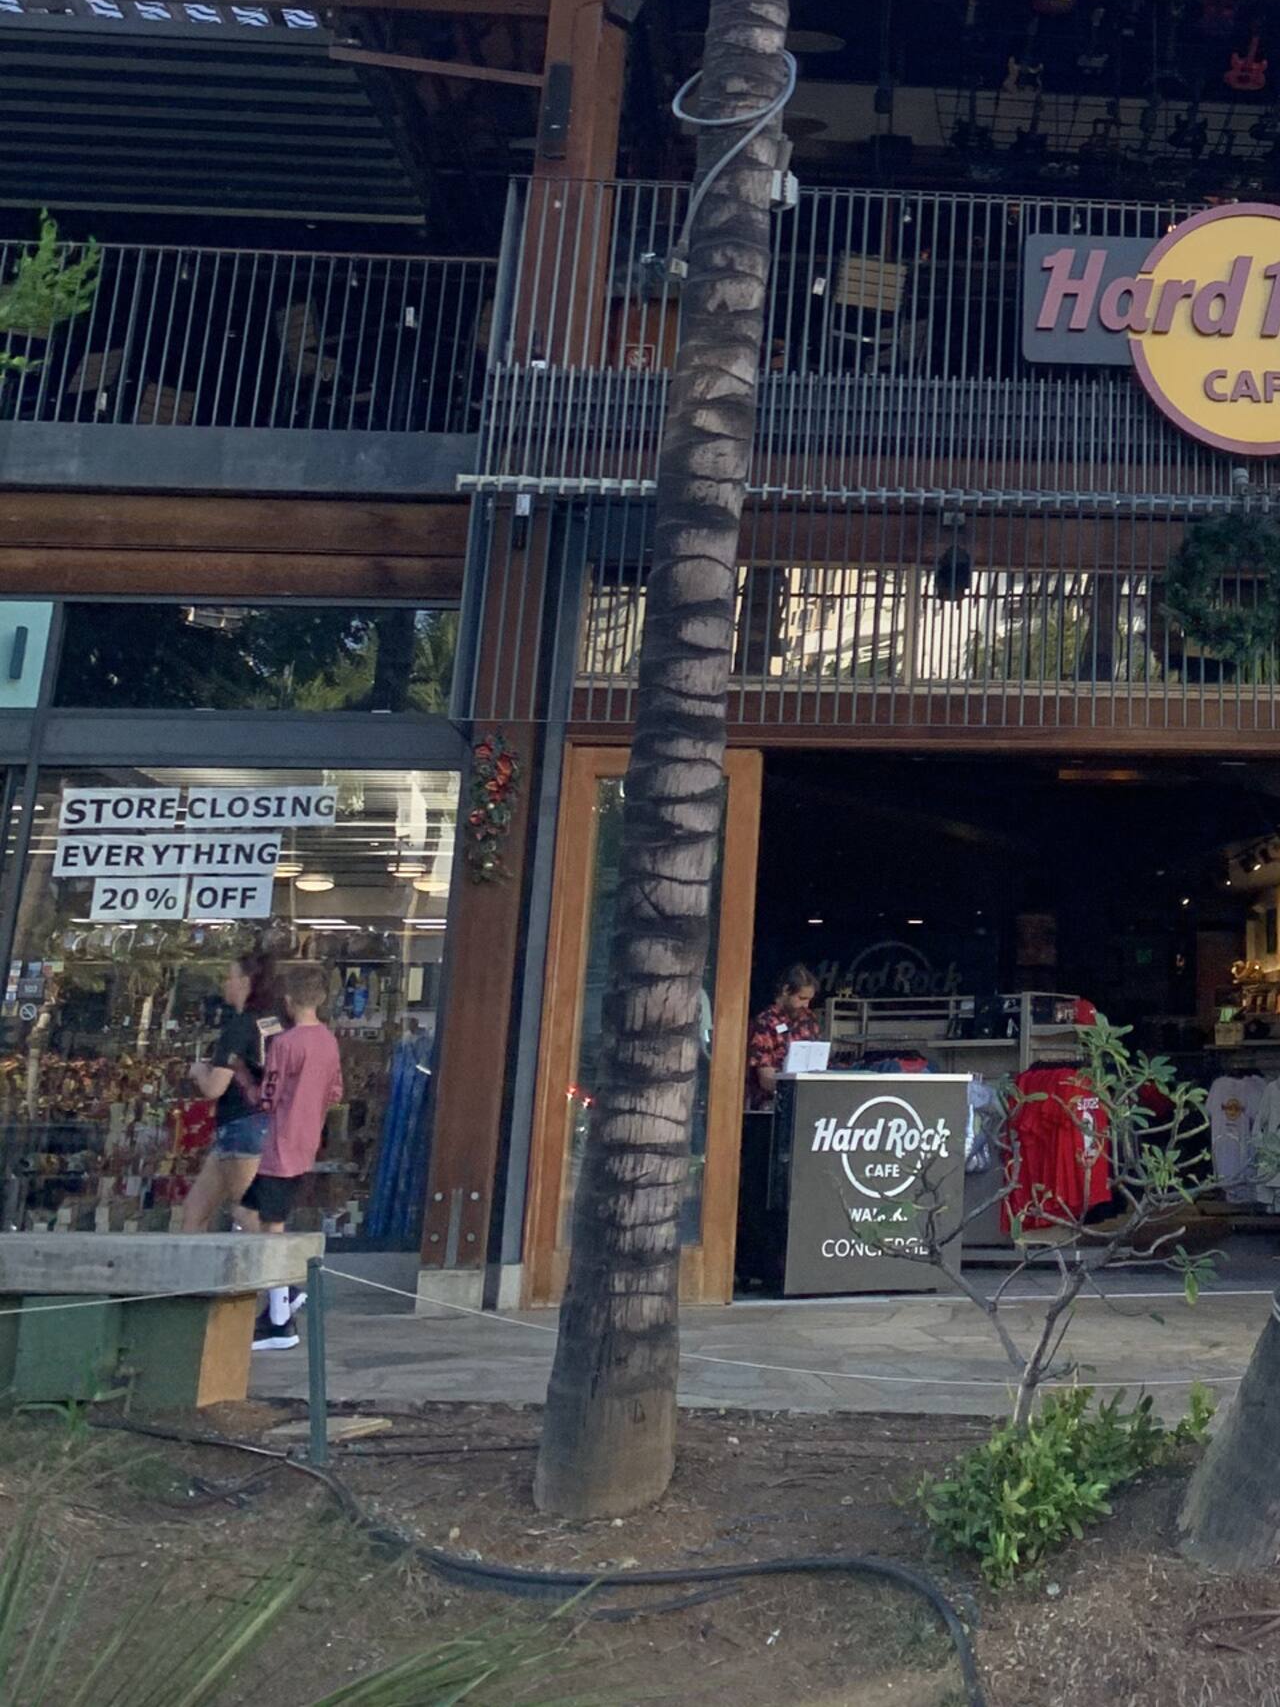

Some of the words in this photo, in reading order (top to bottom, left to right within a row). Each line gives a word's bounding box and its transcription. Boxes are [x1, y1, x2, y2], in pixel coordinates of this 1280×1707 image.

[1036, 248, 1253, 336] Hard
[63, 797, 177, 825] STORE
[188, 795, 335, 819] CLOSING
[61, 843, 279, 868] EVERYTHING
[99, 887, 178, 911] 20%
[196, 887, 257, 909] OFF
[811, 1118, 885, 1152] Hard
[885, 1118, 951, 1158] Rock
[865, 1164, 900, 1178] CAFE
